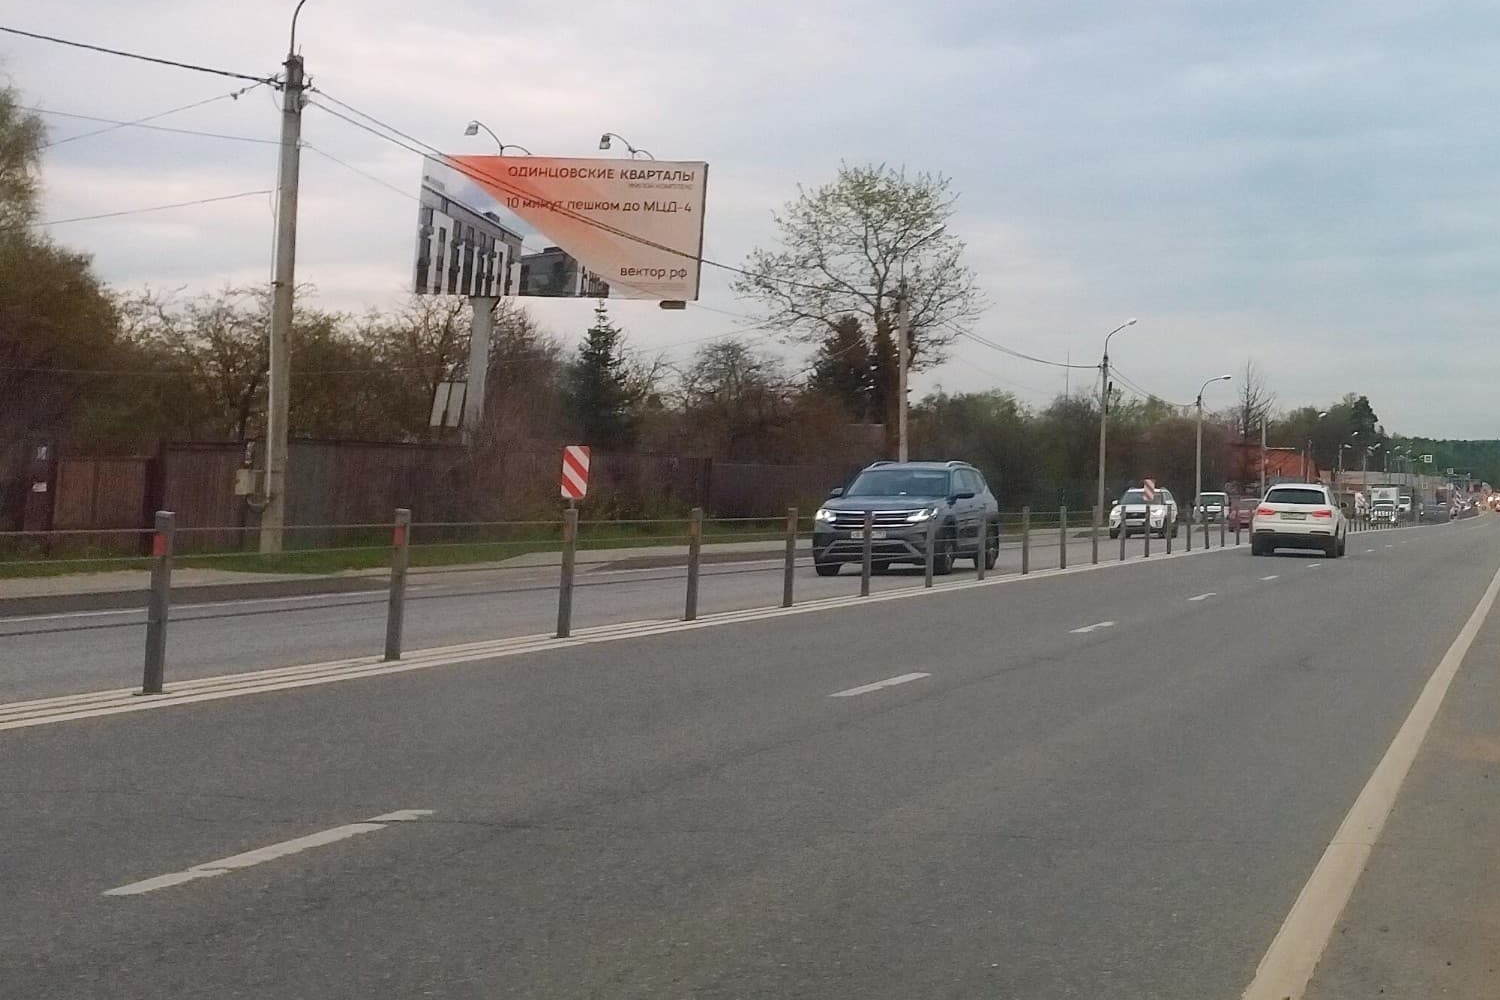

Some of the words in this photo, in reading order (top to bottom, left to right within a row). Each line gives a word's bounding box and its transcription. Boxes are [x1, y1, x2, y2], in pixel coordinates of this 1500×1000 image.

[508, 166, 615, 180] ОДИНЦОВСКИЕ
[620, 169, 695, 182] КВАРТАЛЫ
[506, 197, 520, 208] 10
[567, 201, 620, 212] пешком
[622, 202, 640, 213] до
[643, 201, 692, 214] МЦД-4
